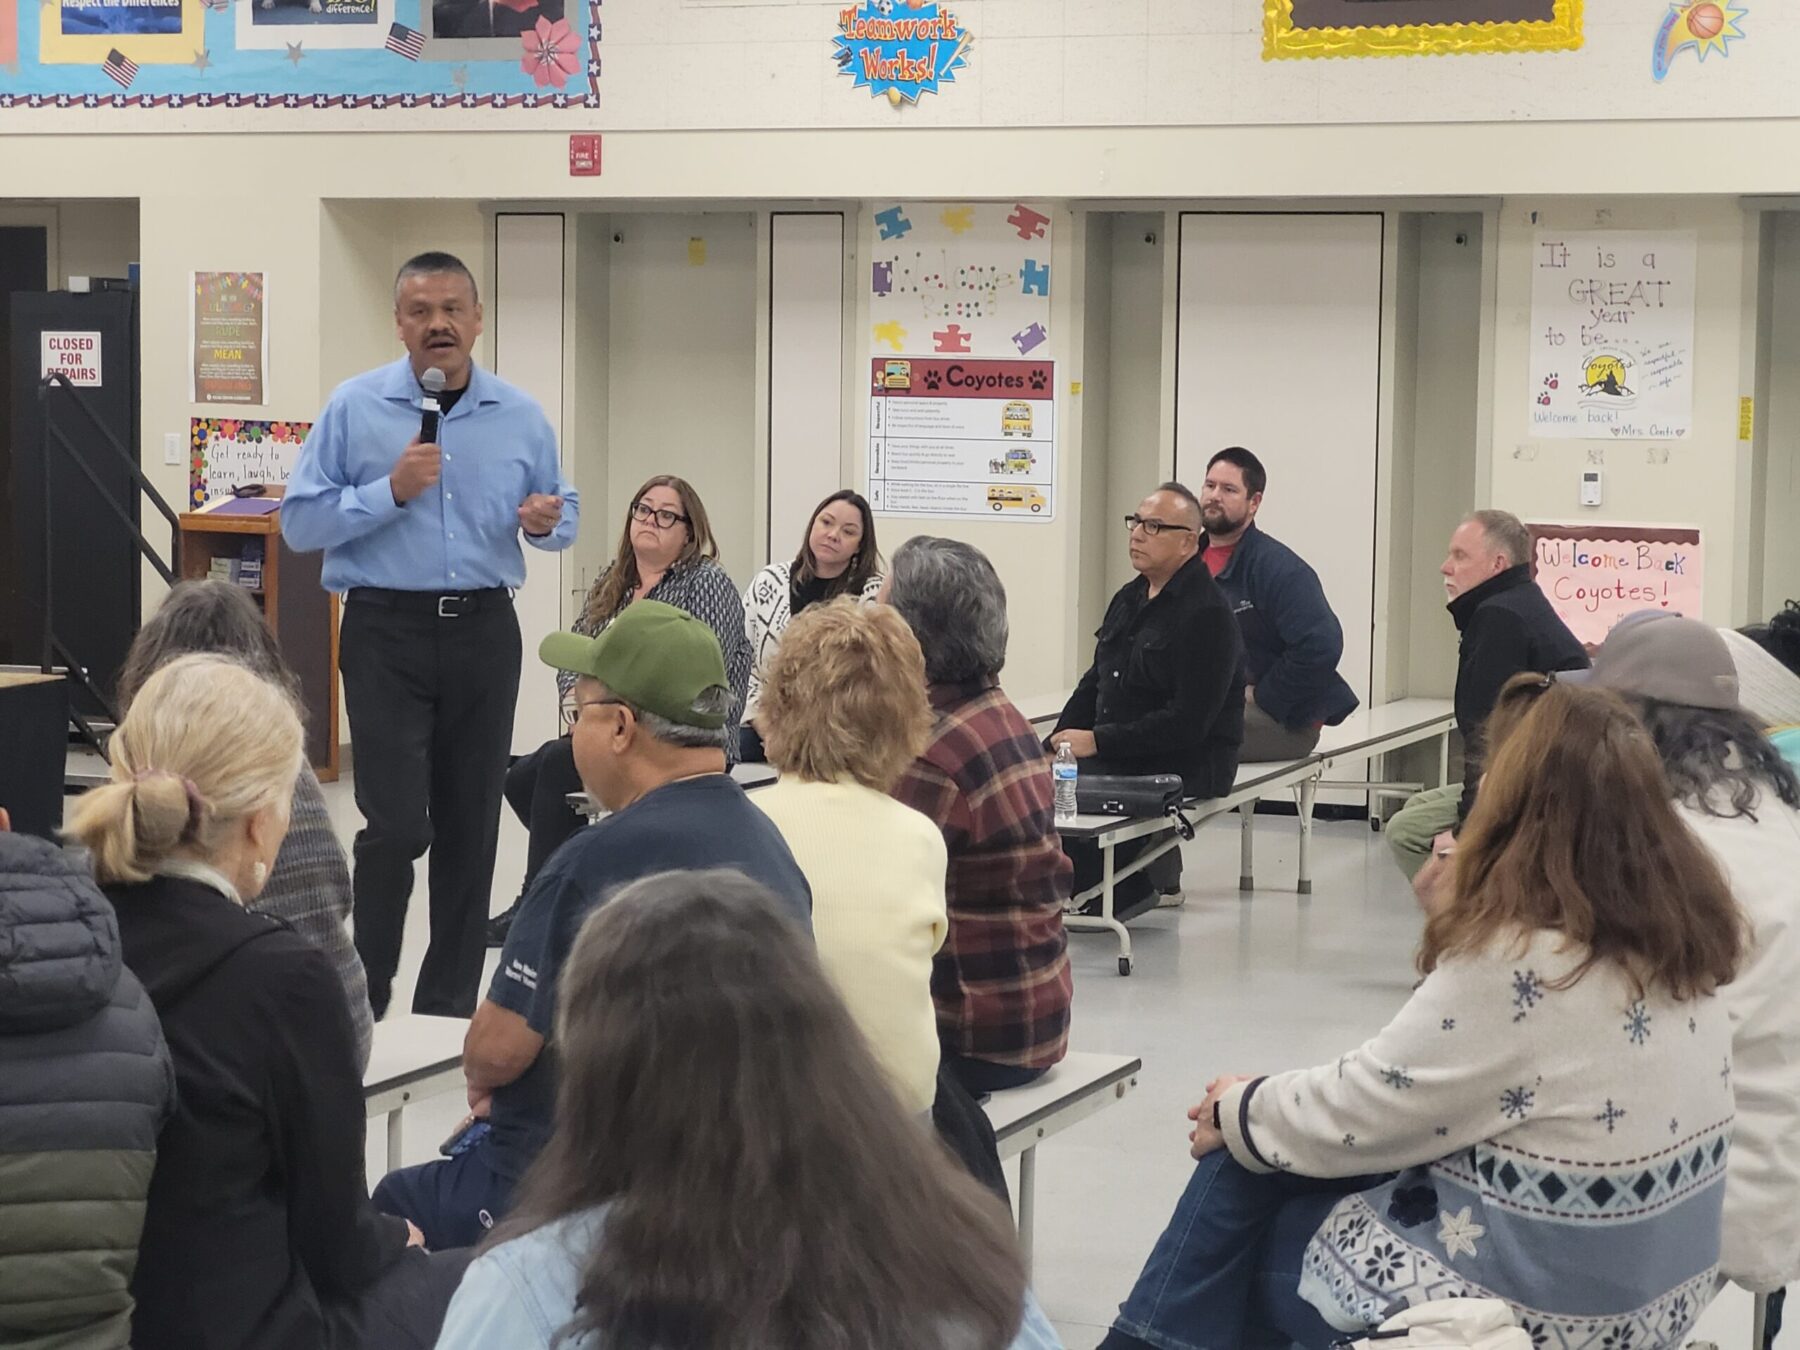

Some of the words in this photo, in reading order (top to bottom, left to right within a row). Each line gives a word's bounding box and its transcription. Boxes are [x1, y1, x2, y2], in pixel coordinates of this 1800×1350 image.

[841, 6, 957, 40] Teamwork
[860, 43, 938, 82] Works!
[1540, 242, 1570, 268] It
[1597, 246, 1616, 268] is
[1642, 252, 1655, 269] a
[1568, 278, 1671, 307] GREAT
[1590, 308, 1635, 329] year
[49, 338, 93, 350] CLOSED
[1545, 326, 1566, 346] to
[60, 353, 82, 365] FOR
[213, 349, 242, 360] MEAN
[946, 365, 1024, 390] Coyotes
[1581, 355, 1634, 379] Coyotes
[1534, 411, 1577, 423] Welcome
[1587, 409, 1619, 423] back!
[211, 444, 229, 463] Get
[237, 445, 264, 467] ready
[270, 447, 279, 459] to
[209, 464, 240, 481] learn,
[243, 464, 275, 484] laugh,
[280, 466, 290, 480] be
[1541, 542, 1630, 570] Welcome
[1636, 544, 1686, 575] Back
[1554, 576, 1669, 613] Coyotes!
